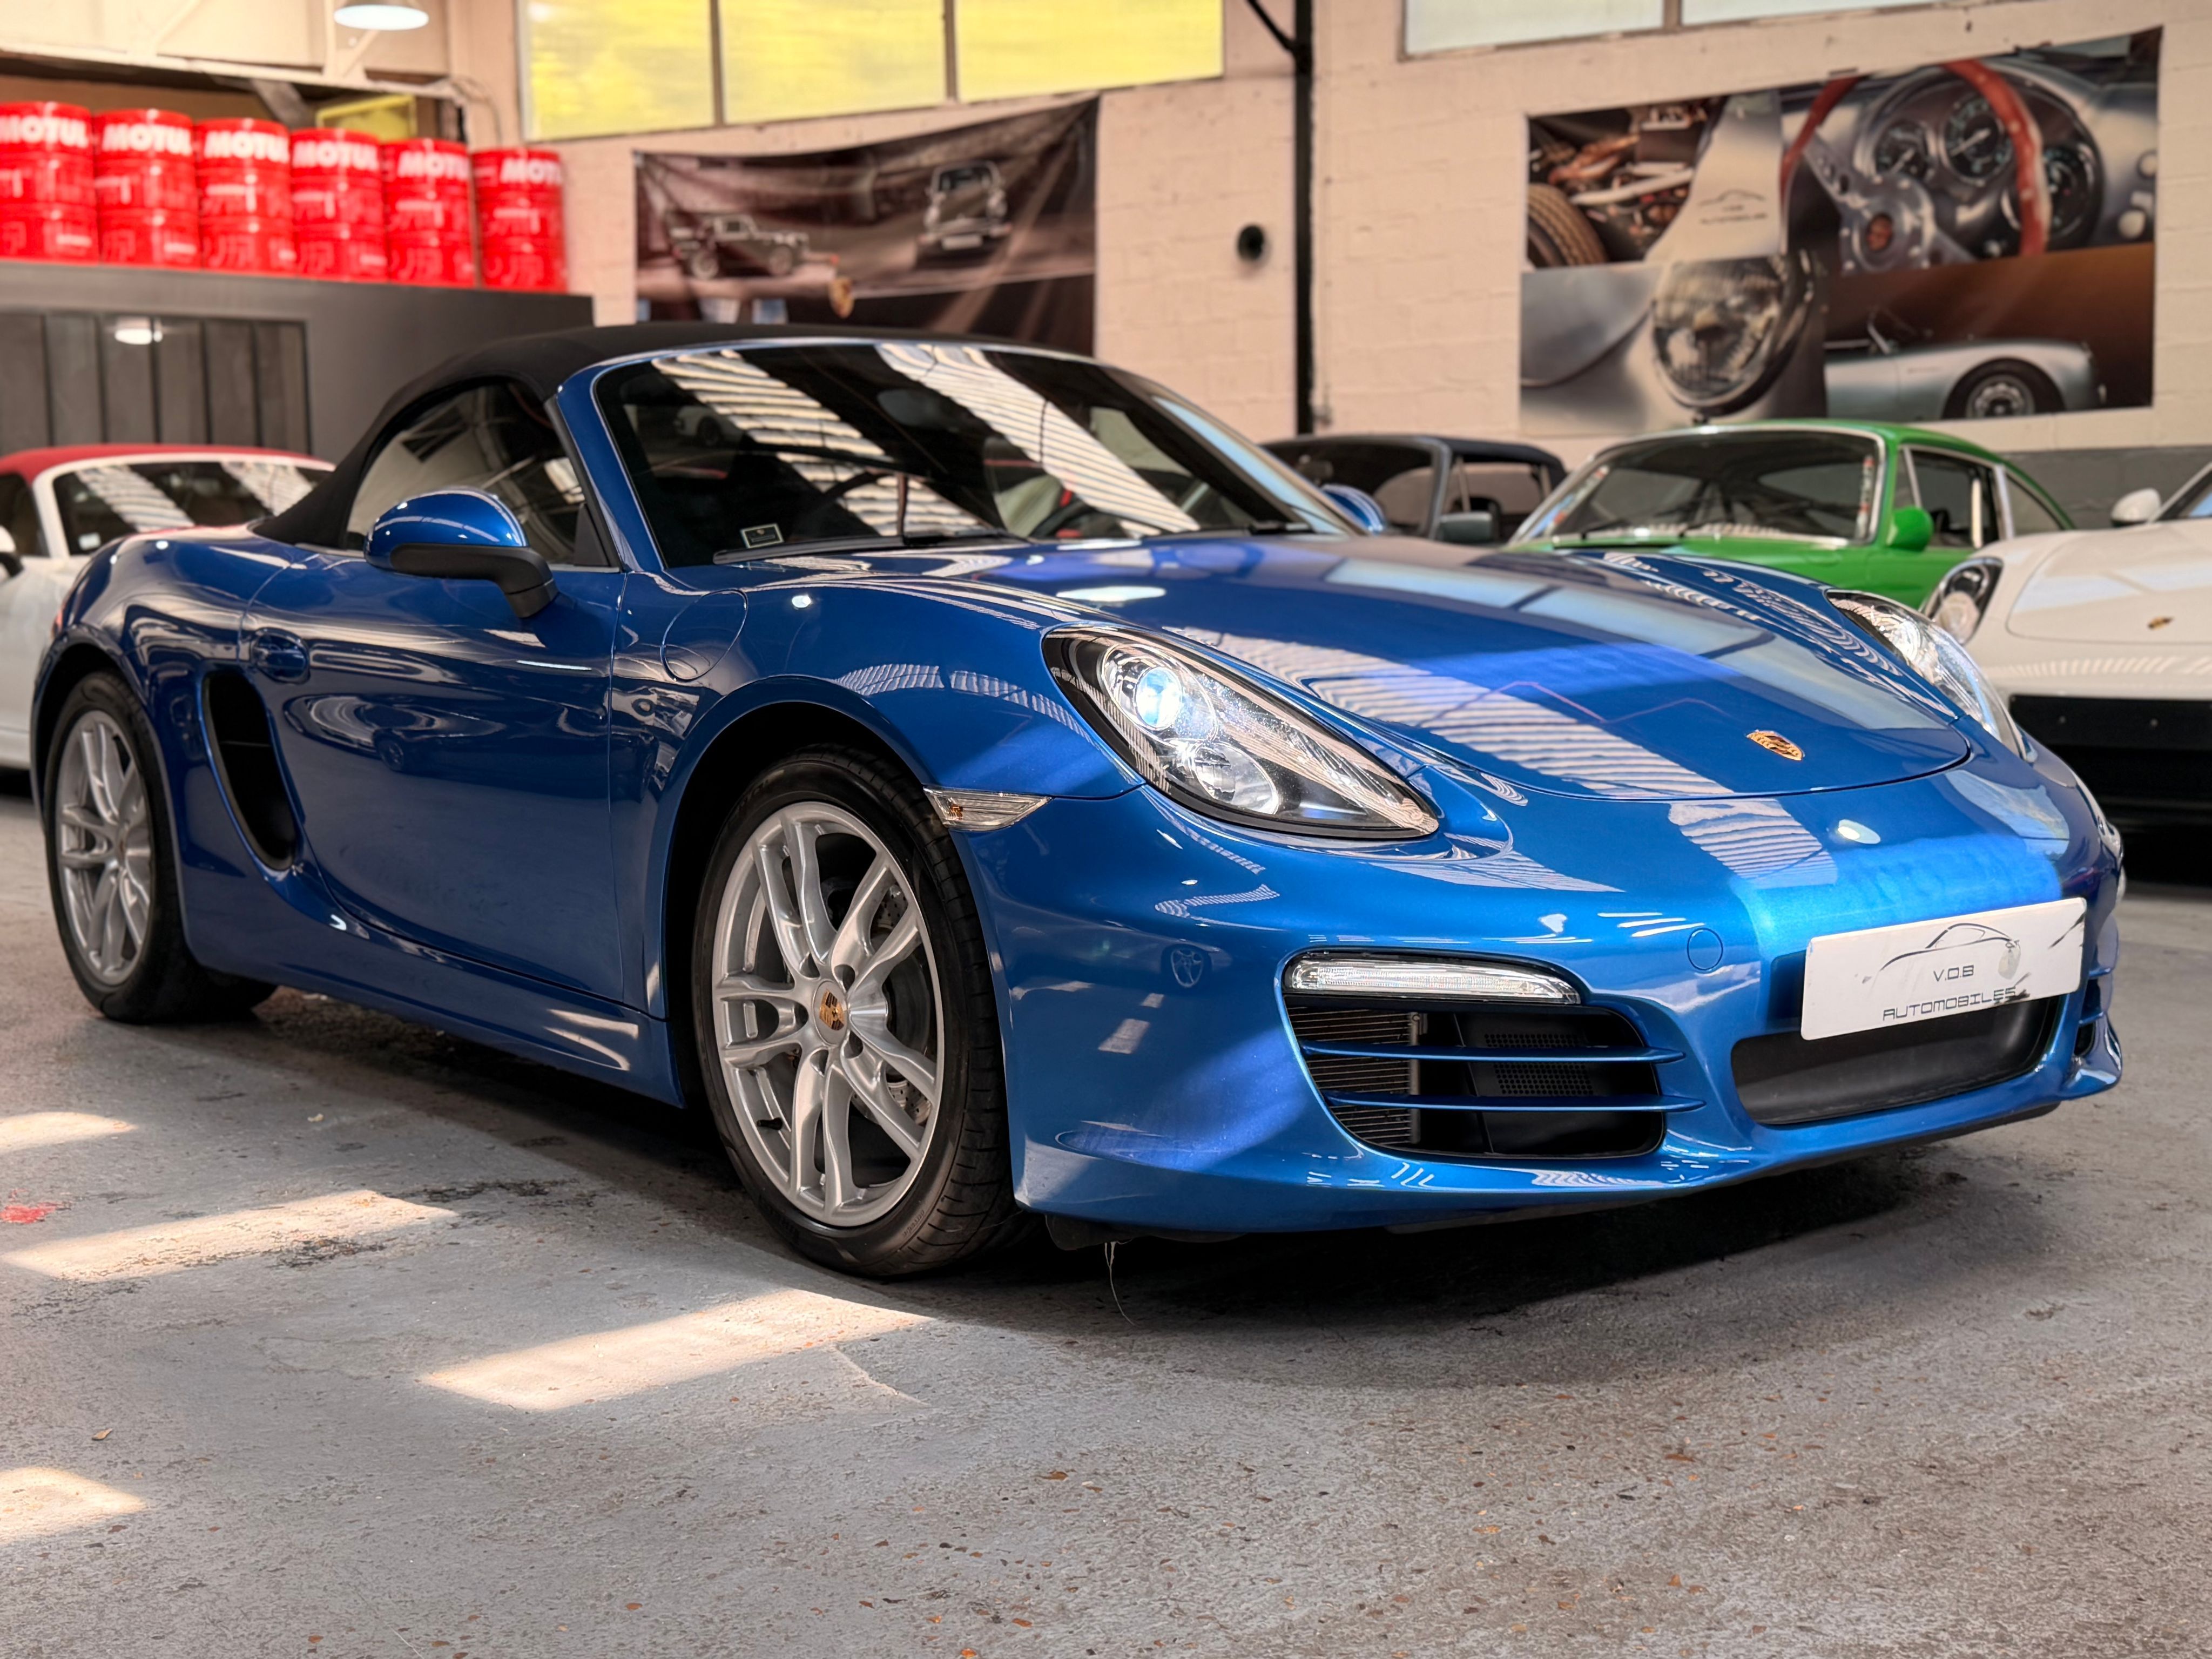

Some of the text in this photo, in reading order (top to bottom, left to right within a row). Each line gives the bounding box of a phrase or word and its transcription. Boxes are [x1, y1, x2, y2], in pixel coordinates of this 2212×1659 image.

[102, 124, 193, 156] MOTUL
[292, 141, 379, 171] MOTUL
[1883, 986, 2017, 1021] AUTOMOBILES
